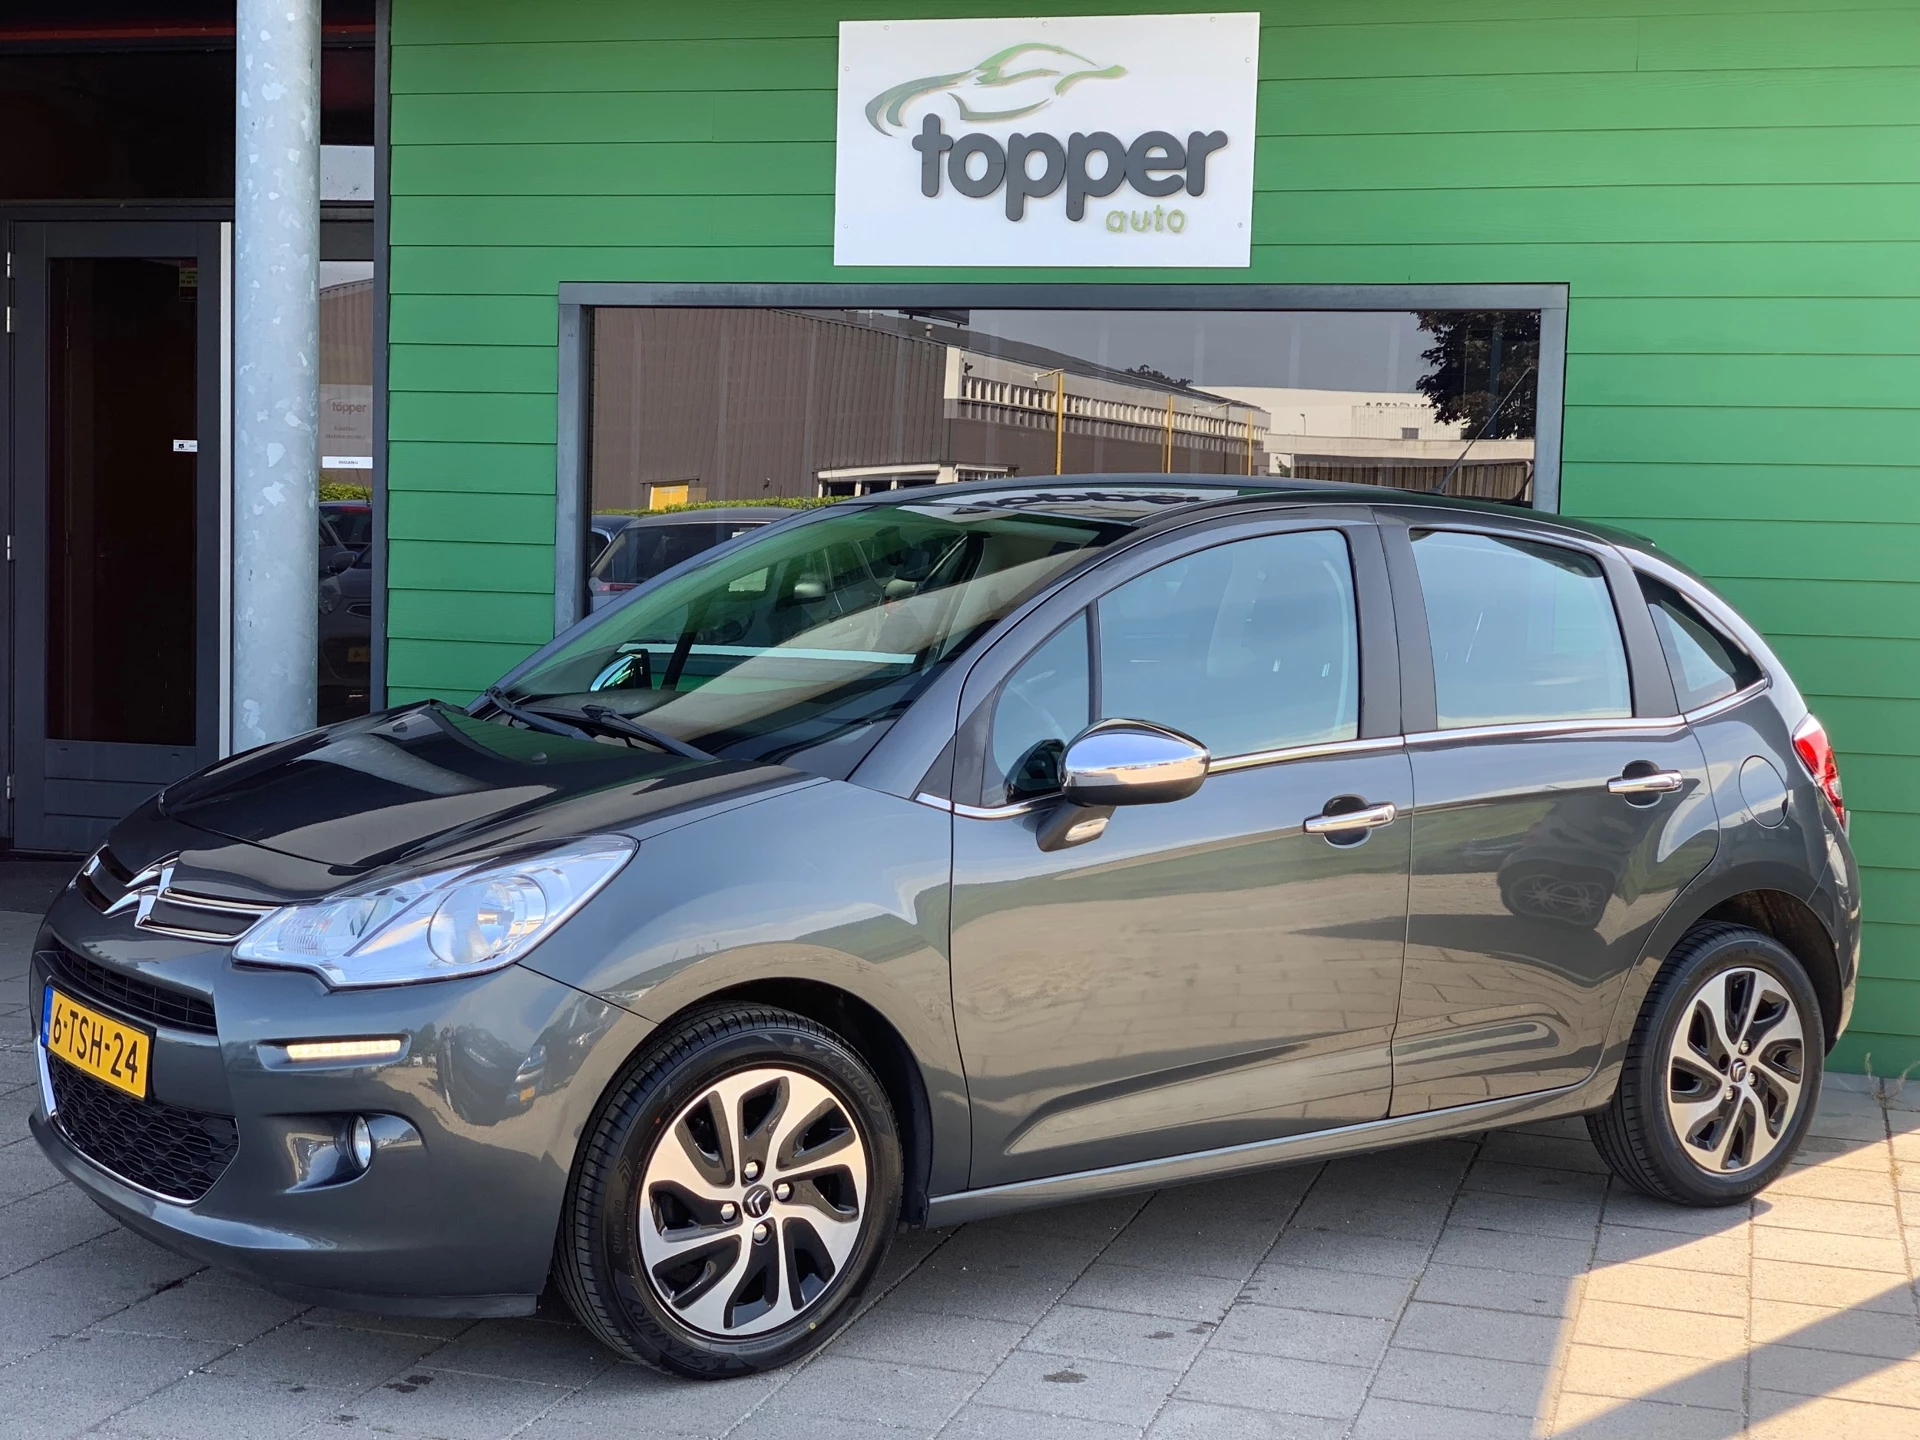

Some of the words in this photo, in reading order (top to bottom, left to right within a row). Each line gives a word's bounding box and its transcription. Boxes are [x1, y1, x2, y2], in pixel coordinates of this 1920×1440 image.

[912, 113, 1228, 222] topper
[1105, 204, 1187, 233] auto
[332, 401, 367, 415] topper
[54, 1003, 138, 1083] 6-TSH-24
